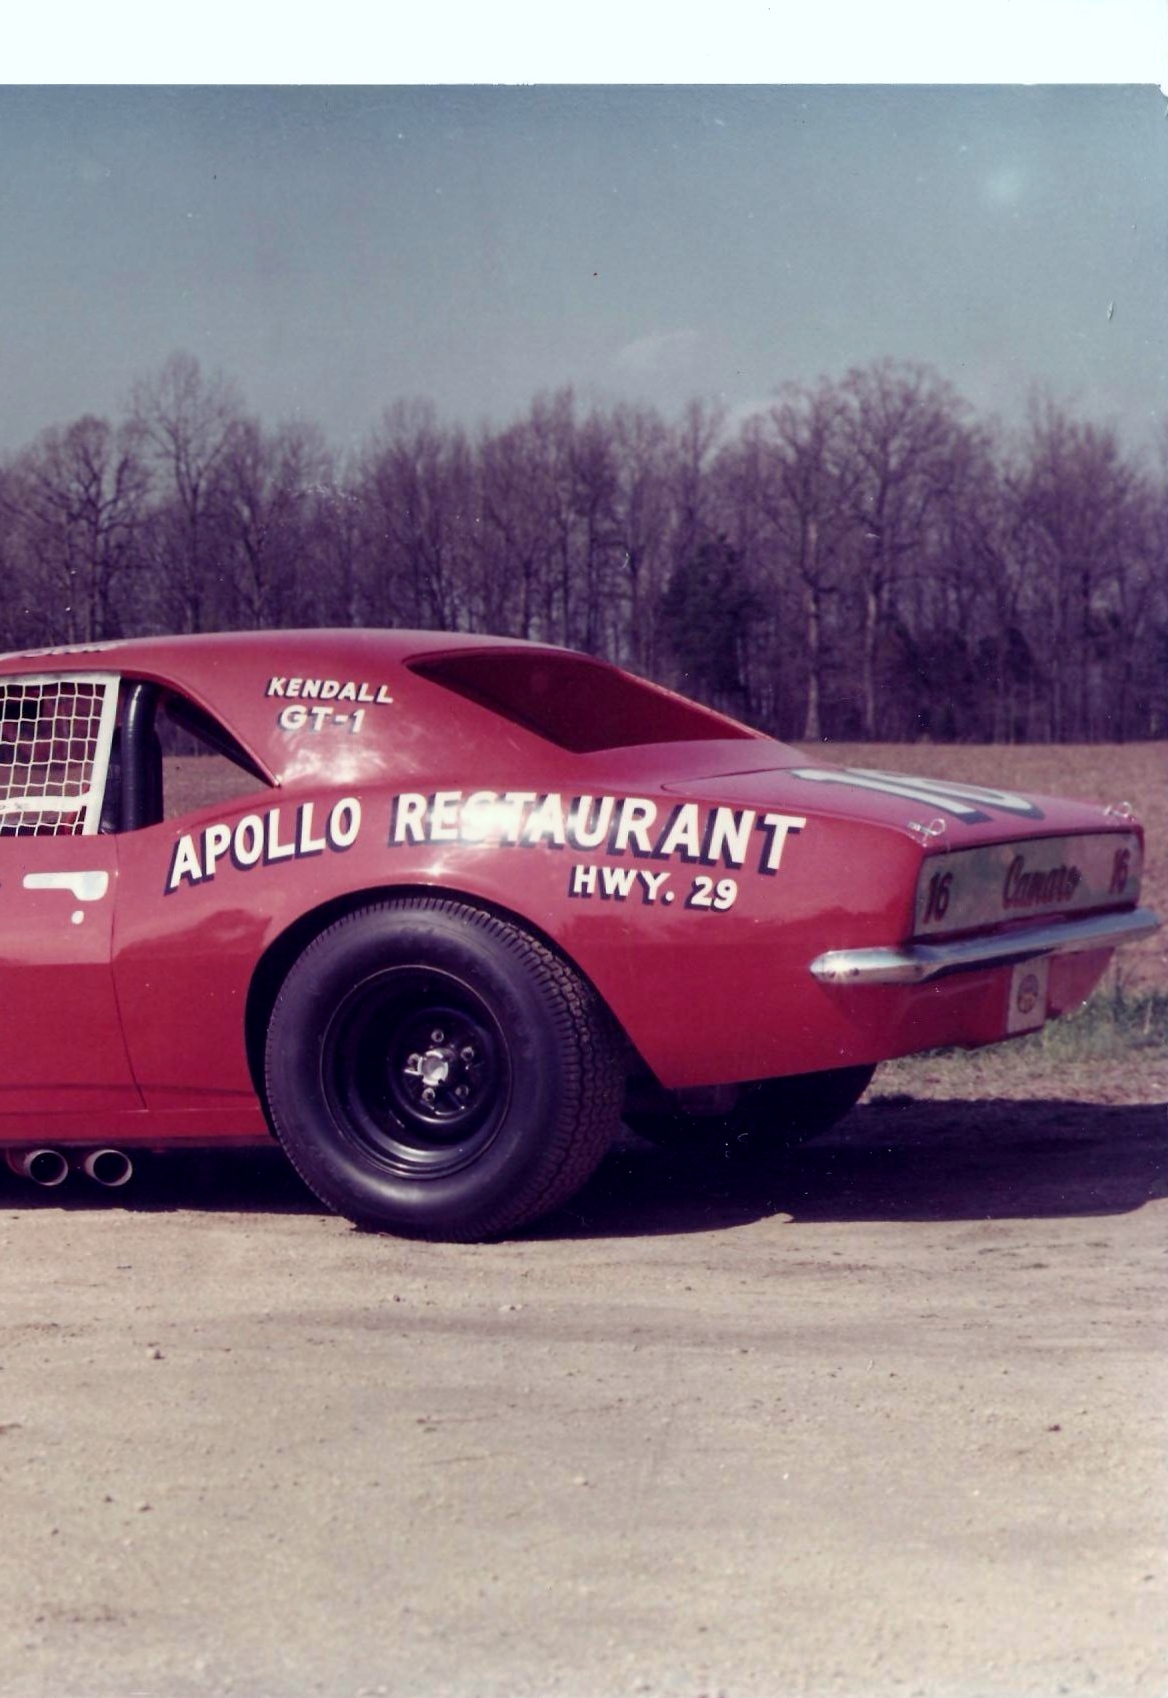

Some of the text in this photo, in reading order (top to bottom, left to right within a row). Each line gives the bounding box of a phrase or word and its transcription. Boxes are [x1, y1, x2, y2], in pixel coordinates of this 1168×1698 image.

[266, 676, 394, 704] KENDALL
[278, 704, 365, 735] GT-1
[167, 791, 807, 892] APOLLO RESTAURANT
[570, 864, 739, 912] HWY. 29
[923, 870, 953, 924] 16
